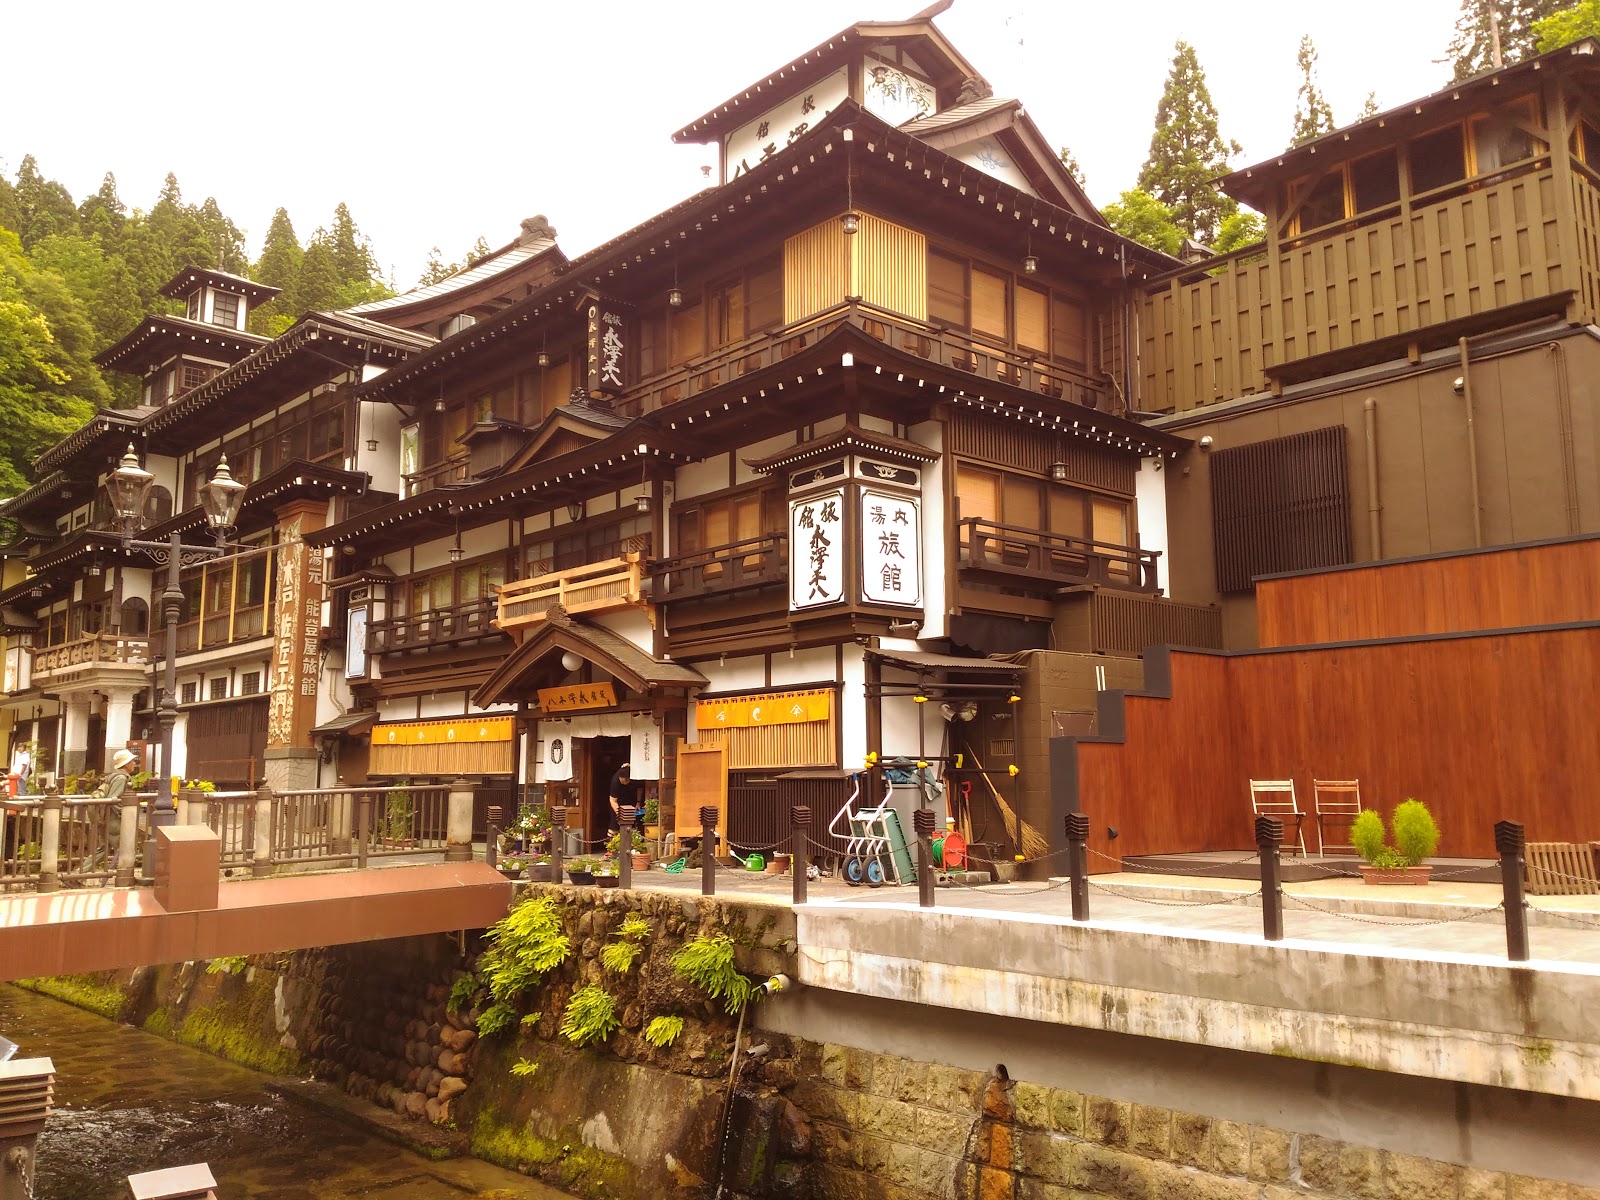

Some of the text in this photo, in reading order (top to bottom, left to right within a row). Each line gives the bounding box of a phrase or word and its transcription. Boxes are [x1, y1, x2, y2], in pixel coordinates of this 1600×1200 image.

[602, 326, 624, 386] 永澤平八
[798, 501, 840, 530] 旅館
[808, 524, 831, 600] 永澤平八
[878, 531, 905, 592] 旅館
[302, 546, 322, 697] 湯元 能登屋旅館
